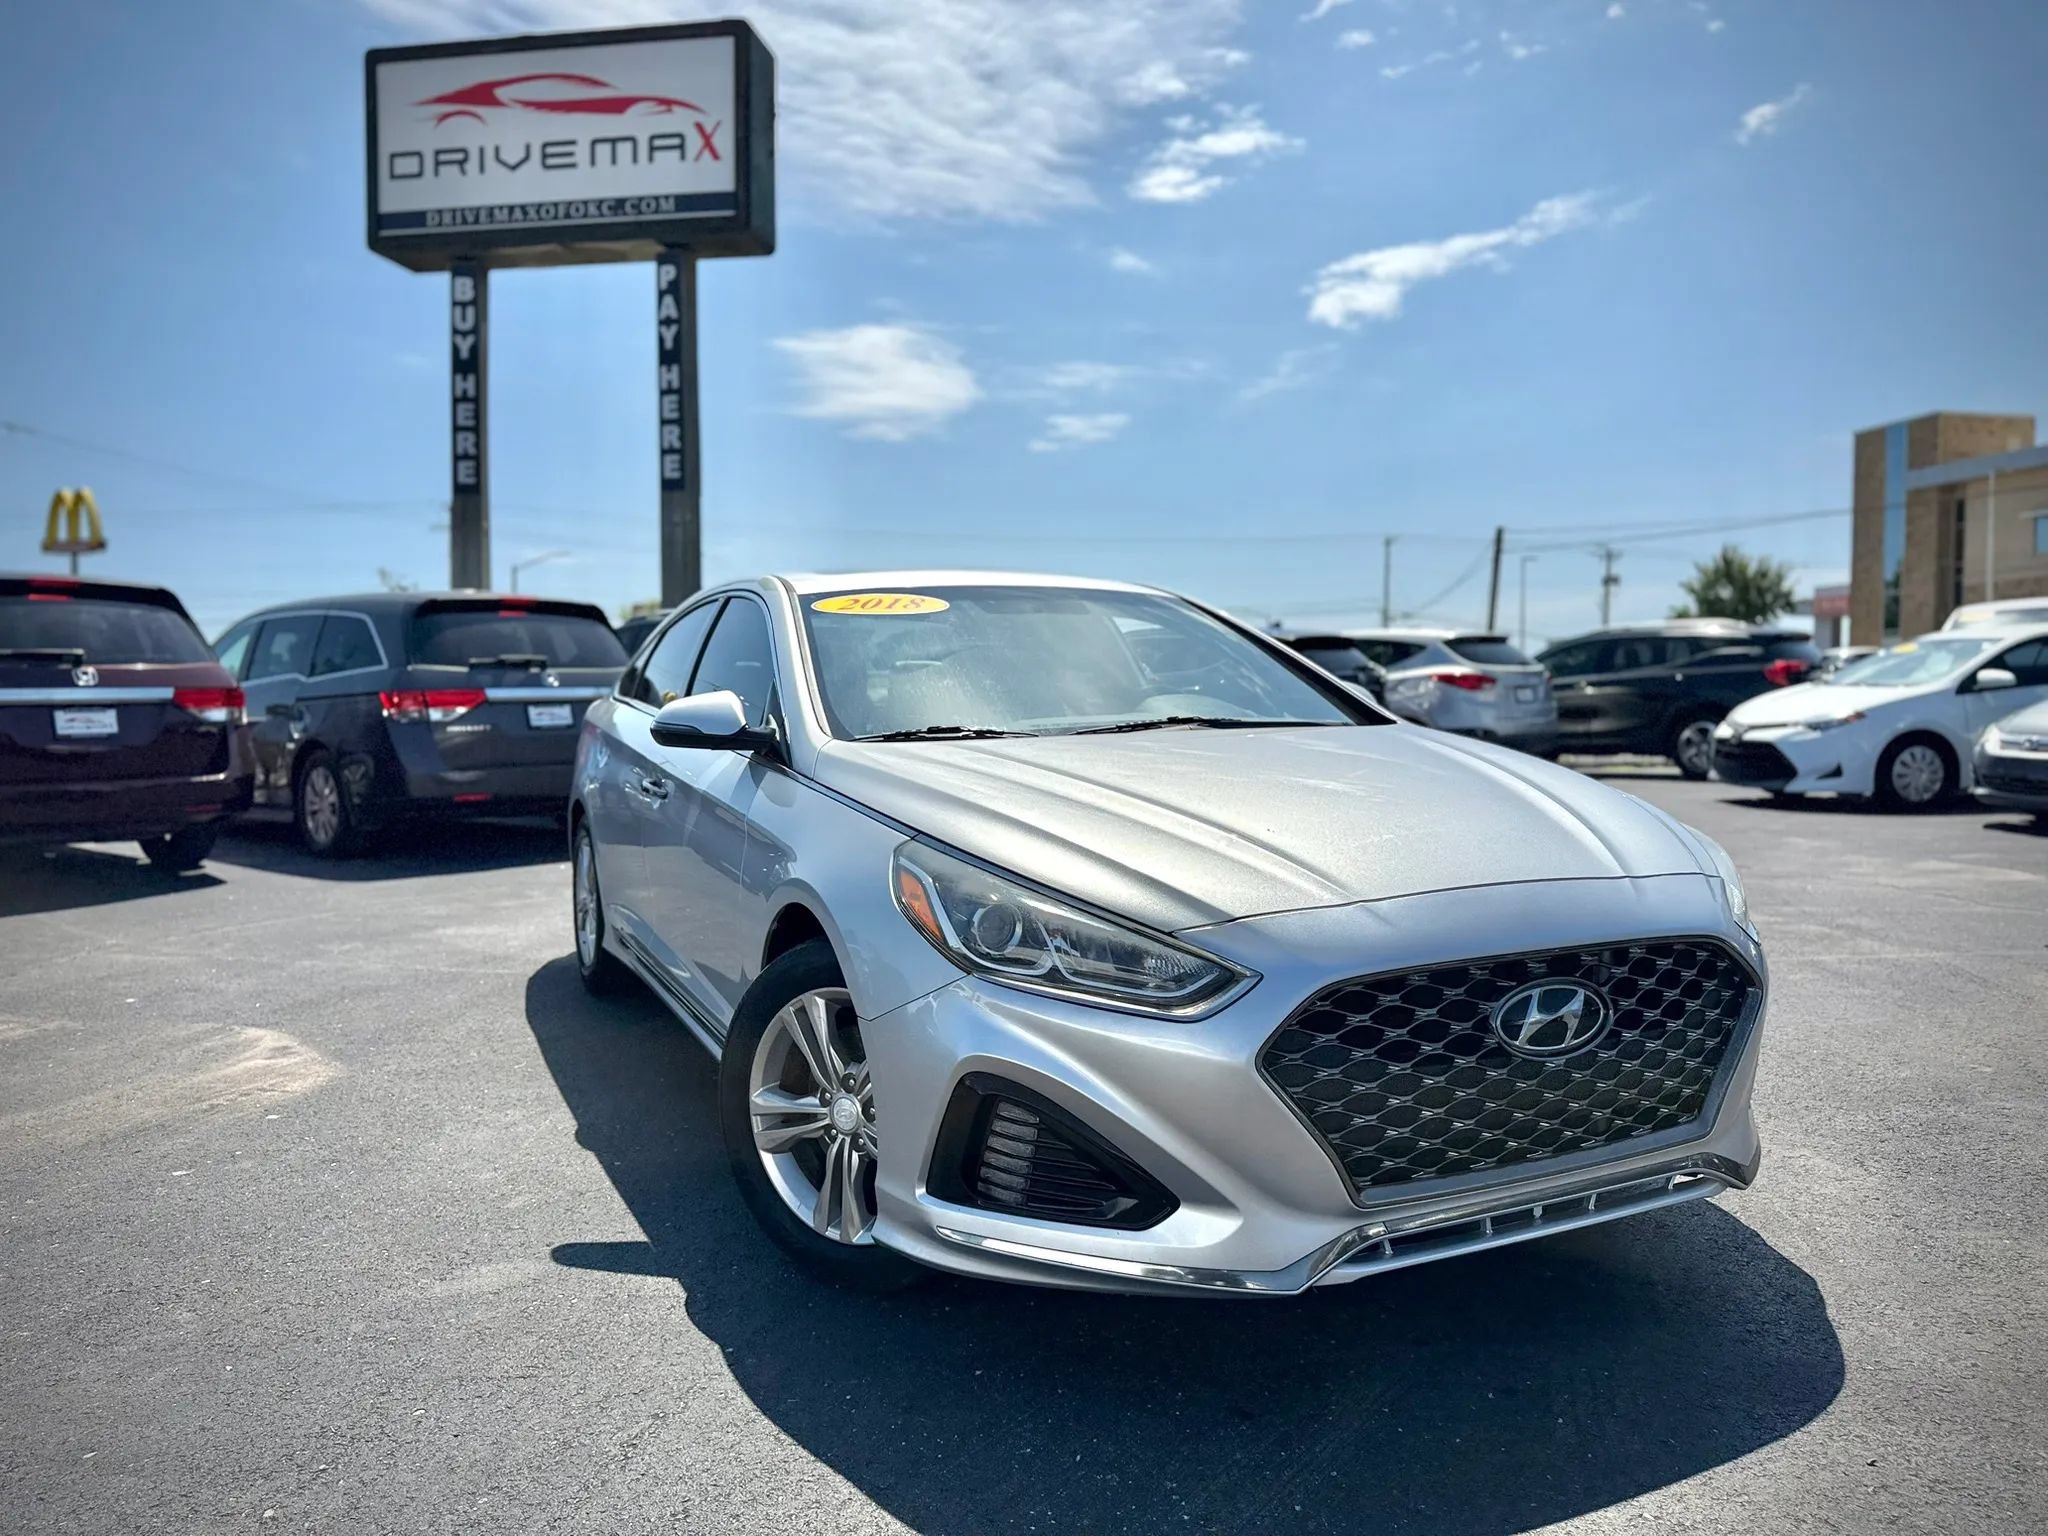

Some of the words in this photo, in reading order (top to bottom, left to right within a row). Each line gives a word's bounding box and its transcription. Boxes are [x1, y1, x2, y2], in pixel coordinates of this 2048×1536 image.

[389, 120, 722, 180] DRIVEMAX
[425, 196, 676, 227] DRIVEMAXOFOKC.COM
[453, 275, 476, 360] BUY
[658, 263, 679, 351] PAY
[454, 373, 478, 485] HERE
[660, 363, 682, 480] HERE
[837, 597, 926, 611] 2018
